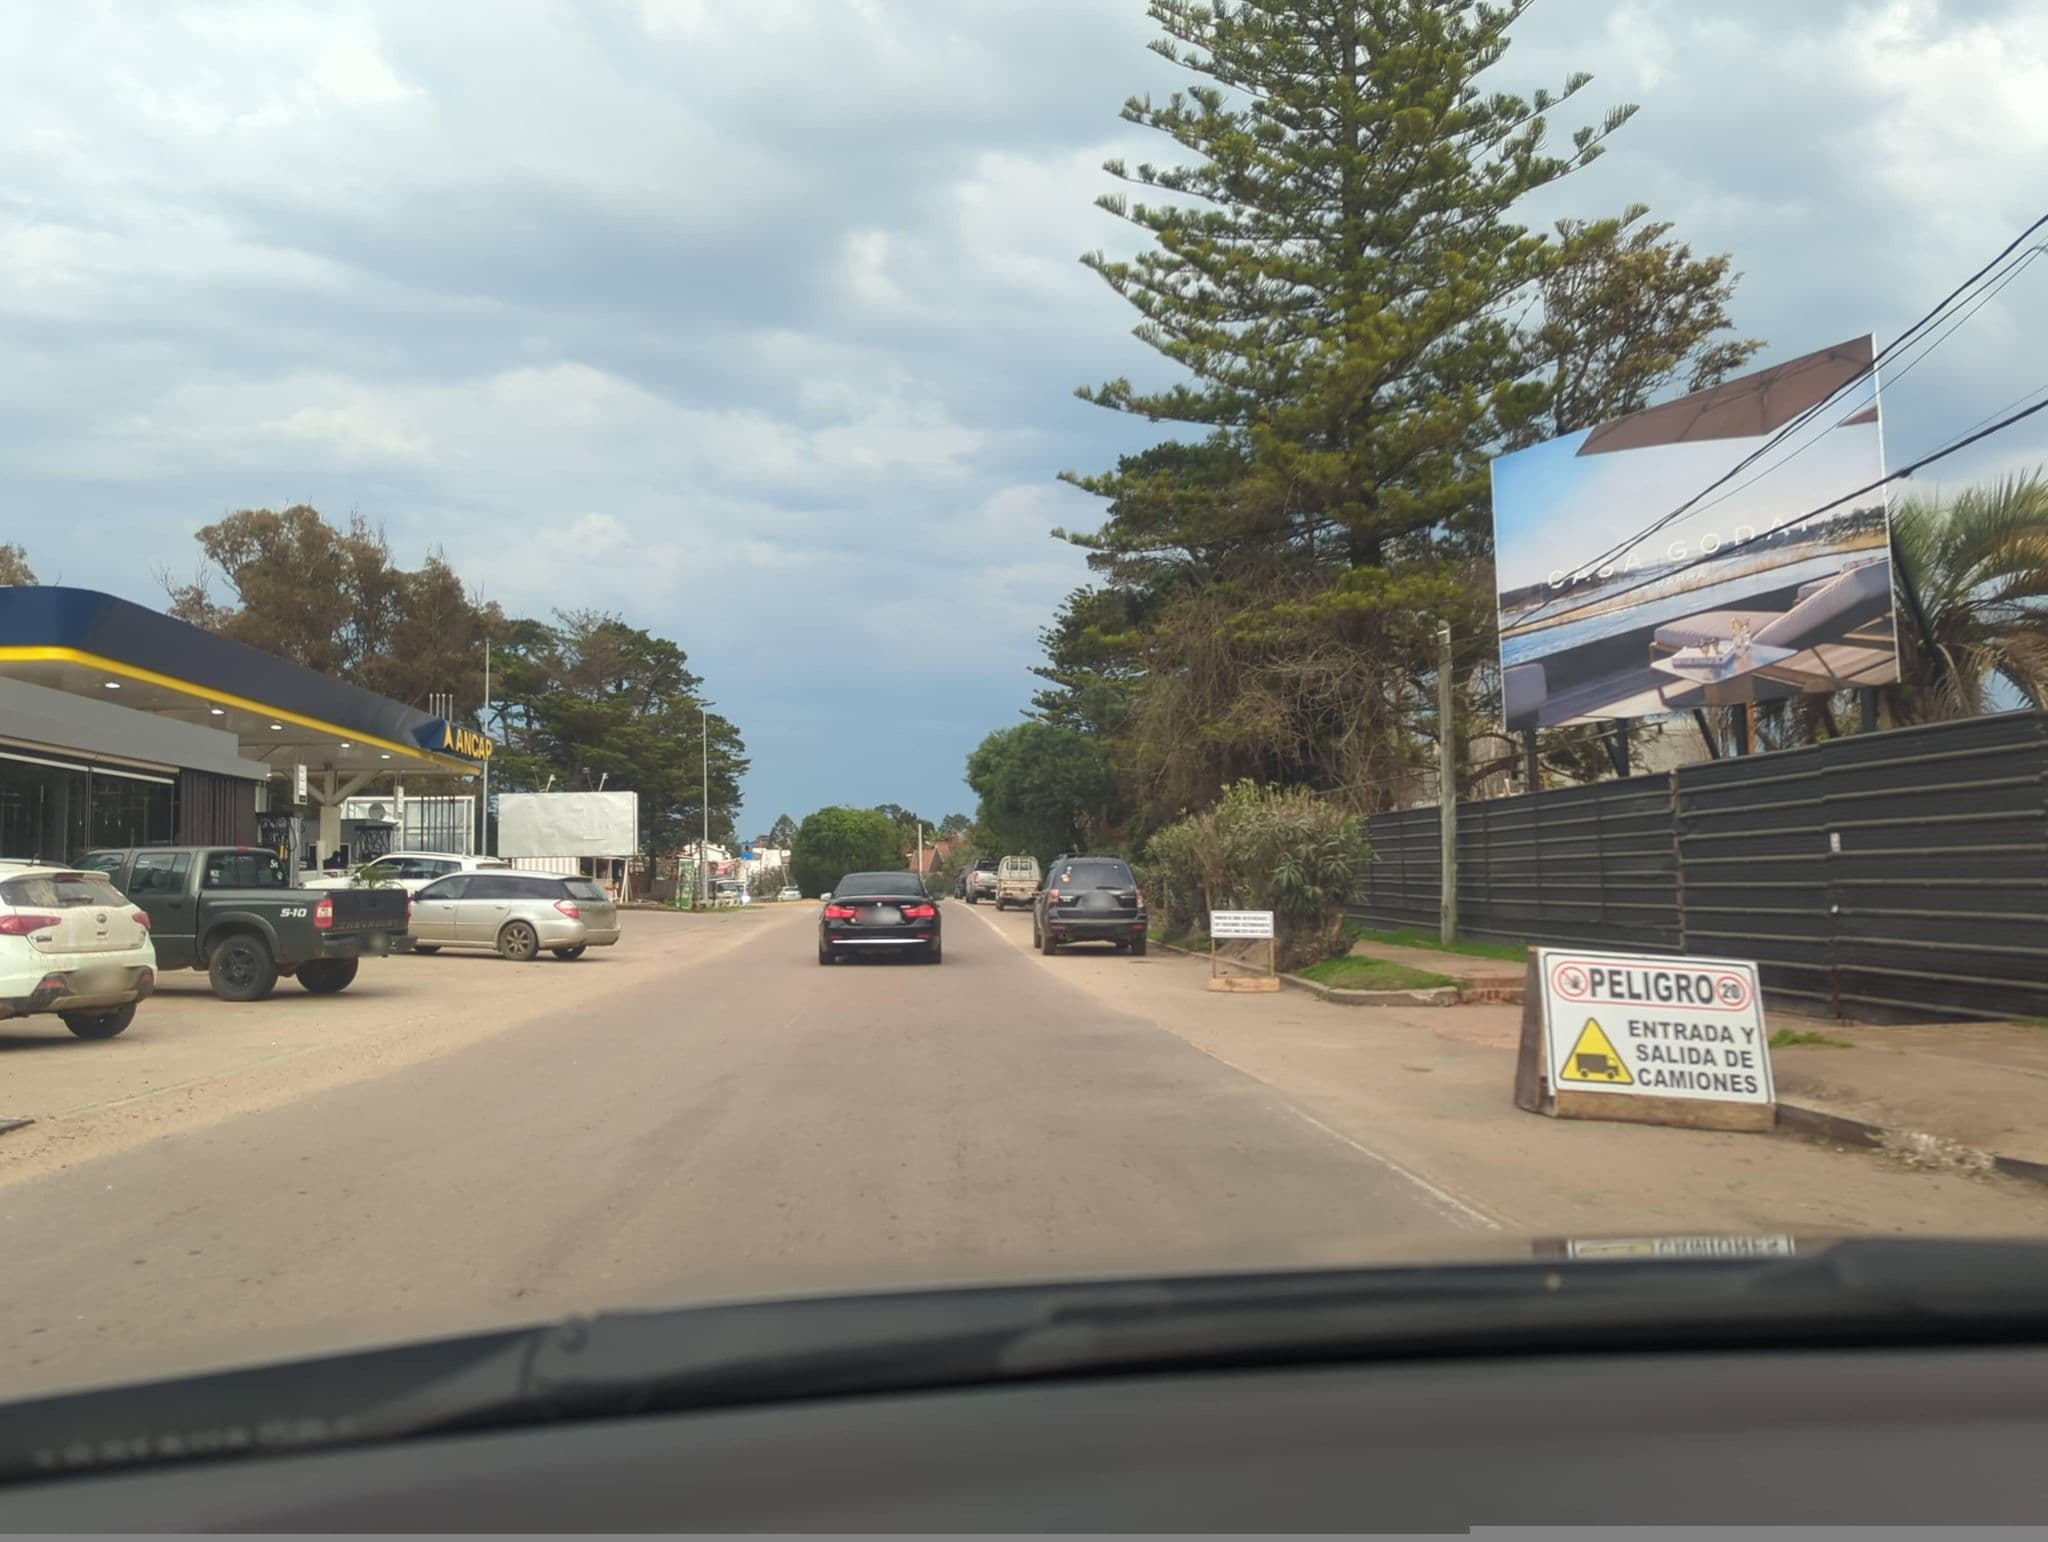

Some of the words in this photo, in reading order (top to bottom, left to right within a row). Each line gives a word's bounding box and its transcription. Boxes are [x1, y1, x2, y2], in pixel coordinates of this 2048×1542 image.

[1548, 553, 1642, 589] CASA
[455, 728, 493, 760] ANCAP
[1588, 968, 1713, 1004] PELIGRO
[1722, 983, 1740, 999] 20
[1629, 1019, 1735, 1042] ENTRADA
[1741, 1026, 1755, 1044] Y
[1636, 1044, 1717, 1066] SALIDA
[1726, 1050, 1754, 1069] DE
[1638, 1068, 1758, 1094] CAMIONES
